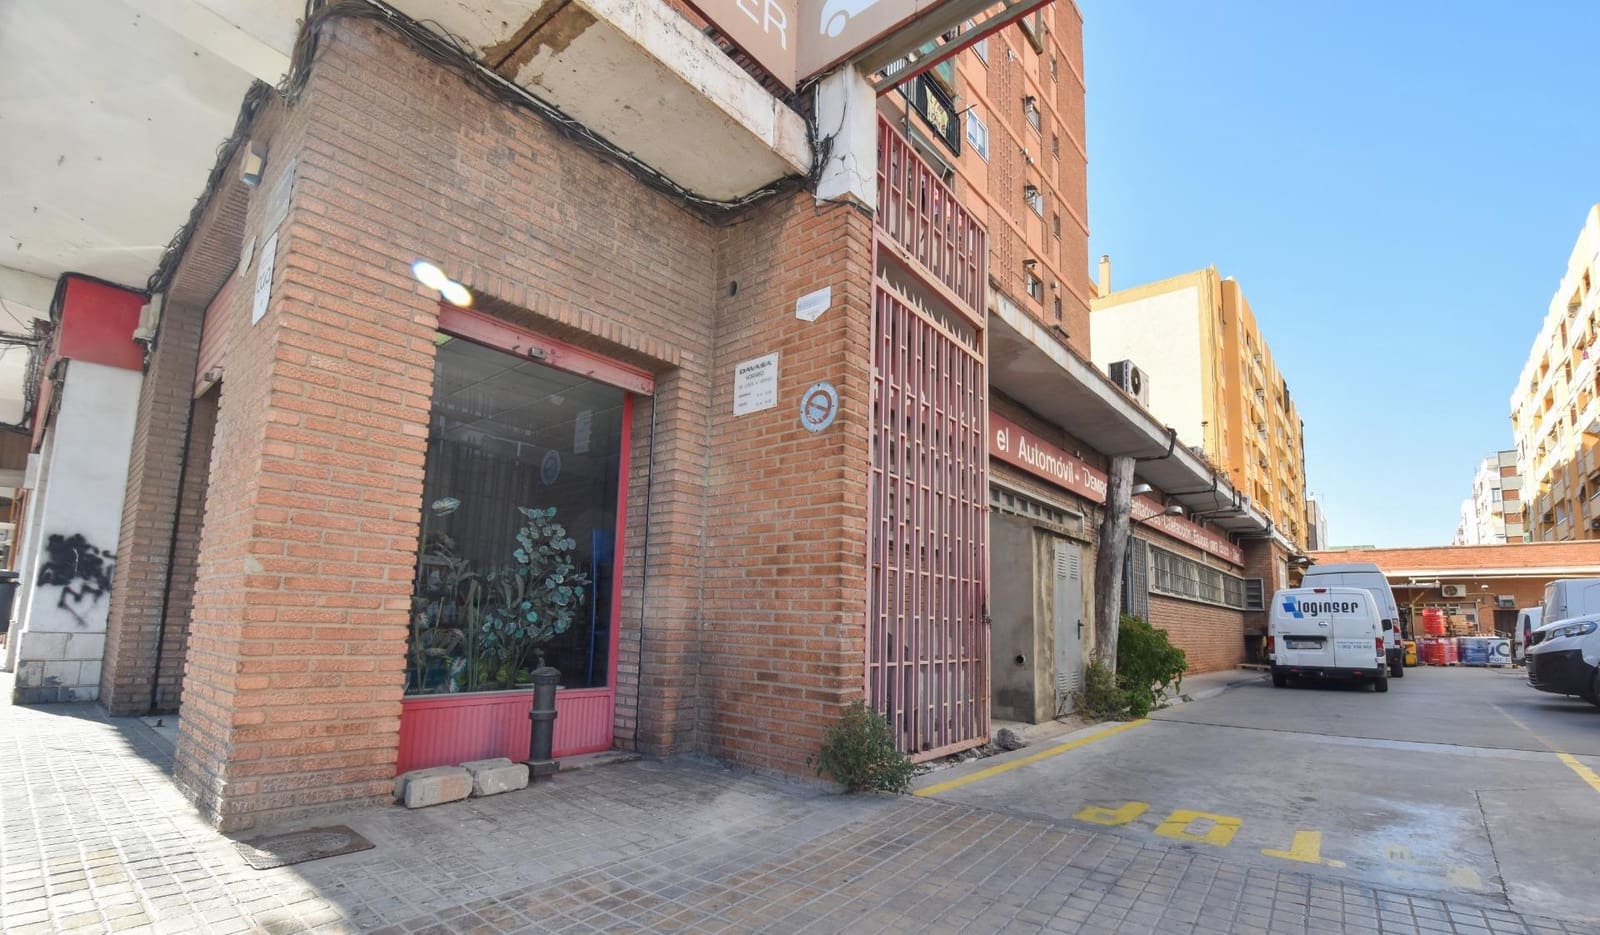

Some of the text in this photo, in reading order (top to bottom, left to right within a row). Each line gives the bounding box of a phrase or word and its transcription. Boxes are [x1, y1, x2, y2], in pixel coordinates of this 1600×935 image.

[739, 360, 773, 375] DAVASA
[996, 427, 1009, 453] el
[1018, 435, 1074, 484] Automóvil
[1297, 600, 1359, 617] loginser
